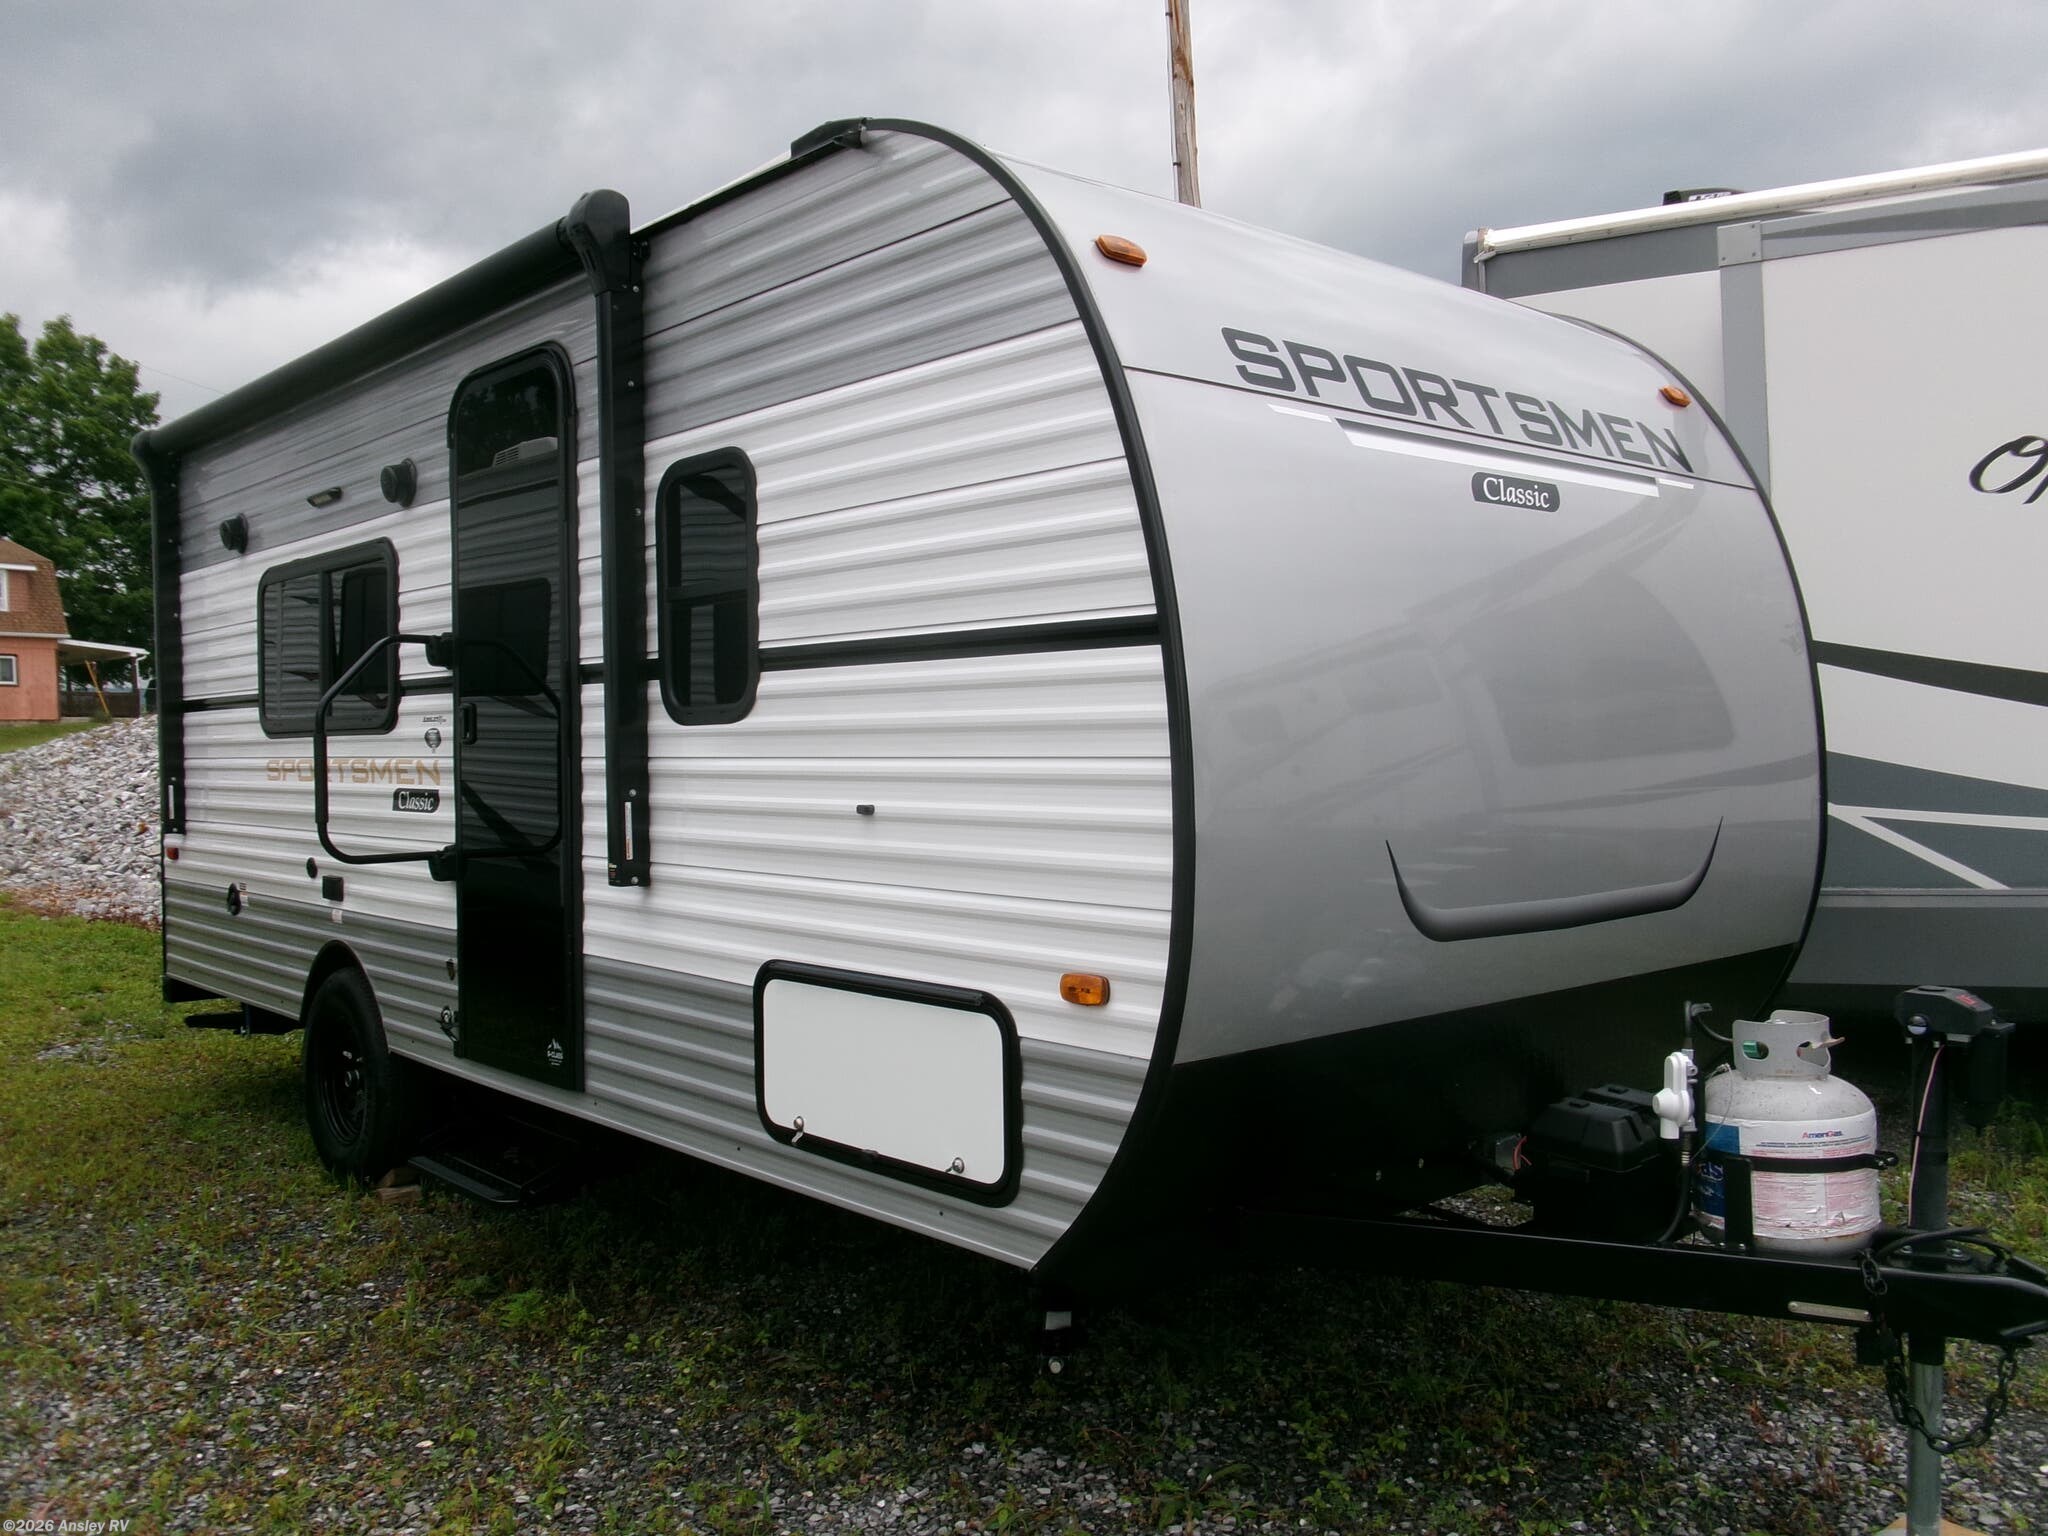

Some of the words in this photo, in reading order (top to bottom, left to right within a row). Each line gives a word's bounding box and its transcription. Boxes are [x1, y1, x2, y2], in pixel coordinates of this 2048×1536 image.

[1221, 327, 1694, 473] SPORTSMEN
[1483, 477, 1550, 508] Classic
[266, 759, 441, 785] SPOTSMEN
[399, 791, 434, 810] Classic
